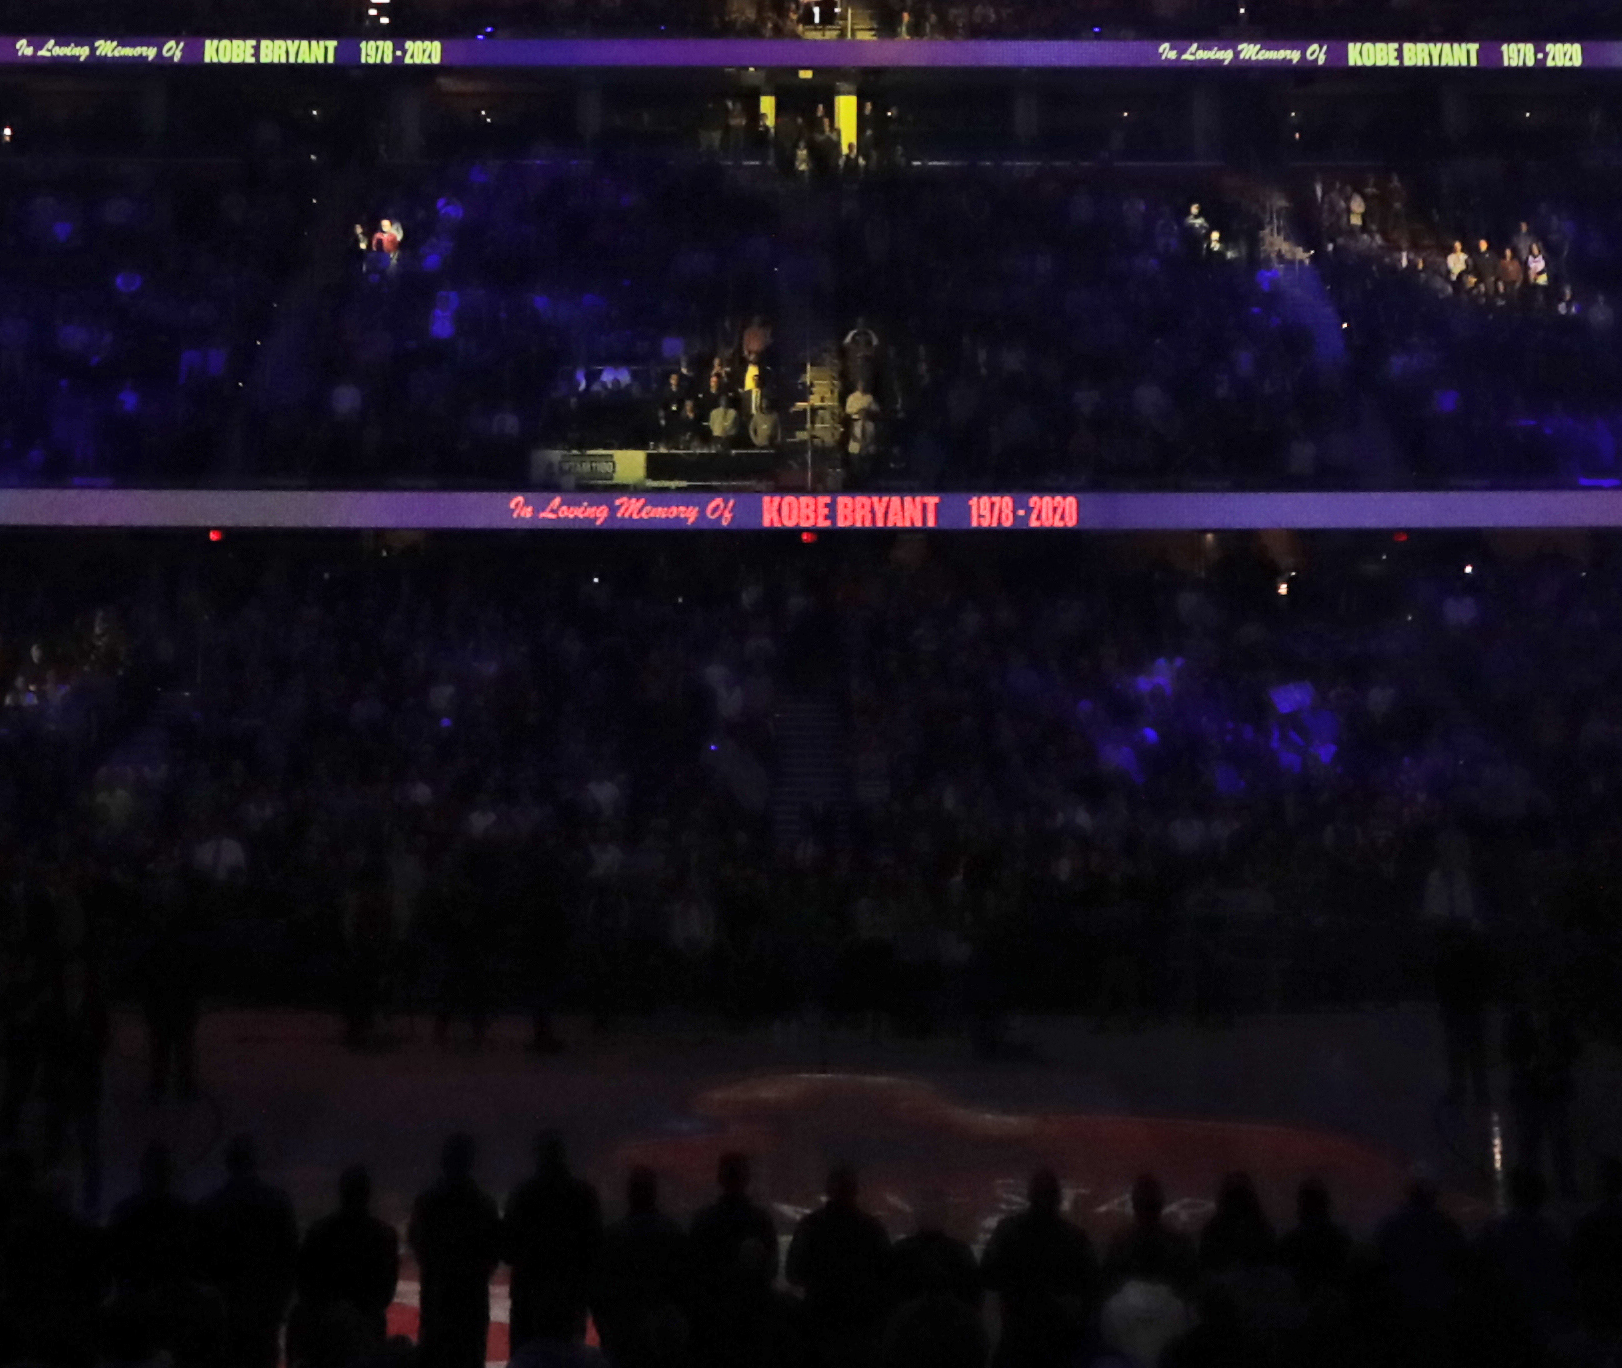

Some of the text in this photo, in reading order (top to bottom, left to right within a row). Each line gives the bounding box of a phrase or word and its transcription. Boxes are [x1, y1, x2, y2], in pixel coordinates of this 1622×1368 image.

[15, 39, 35, 58] In
[37, 39, 89, 60] Loving
[94, 40, 157, 60] Memory
[162, 40, 183, 61] Of
[205, 39, 256, 63] KOBE
[259, 39, 337, 63] BRYANT
[359, 41, 393, 64] 1978
[404, 41, 441, 64] 2020
[1158, 43, 1177, 61] In
[1181, 43, 1233, 63] Loving
[1237, 43, 1301, 64] Memory
[1306, 44, 1327, 64] Of
[1348, 43, 1399, 66] KOBE
[1403, 43, 1479, 66] BRYANT
[1501, 43, 1534, 66] 1978
[1546, 43, 1582, 66] 2020
[509, 498, 533, 519] In
[539, 498, 608, 524] Loving
[614, 498, 699, 524] Memory
[706, 499, 735, 525] Of
[762, 496, 832, 527] KOBE
[836, 496, 939, 527] BRYANT
[968, 496, 1012, 527] 1978
[1027, 496, 1078, 527] 2020
